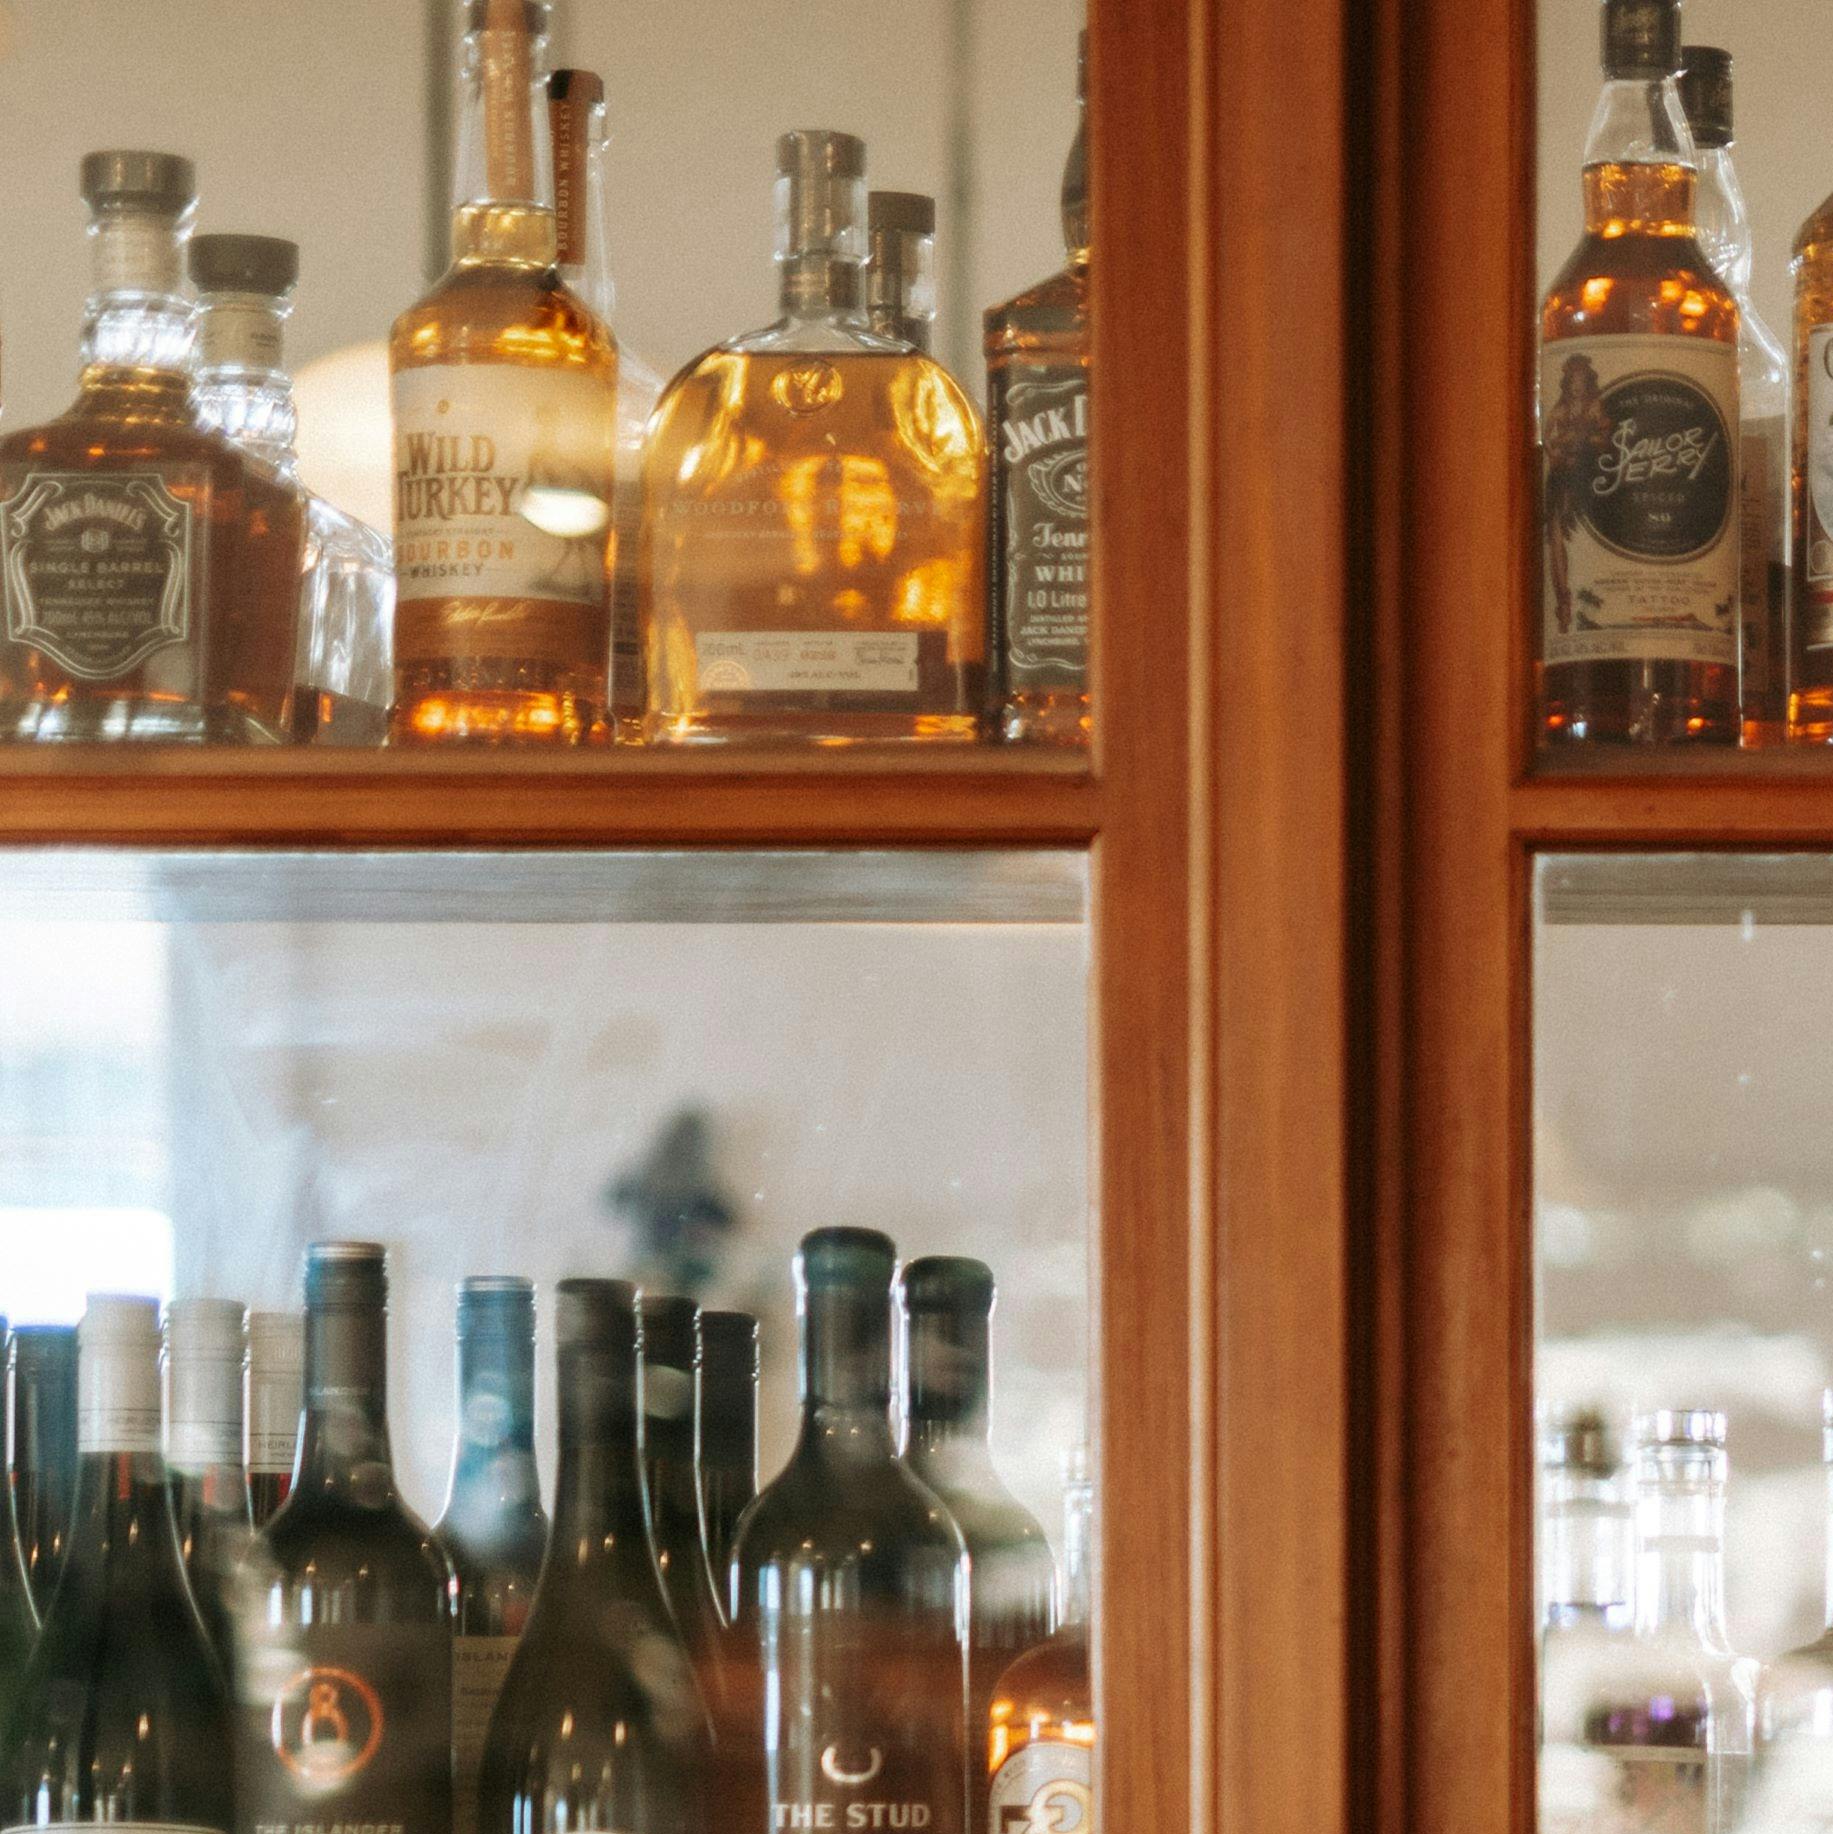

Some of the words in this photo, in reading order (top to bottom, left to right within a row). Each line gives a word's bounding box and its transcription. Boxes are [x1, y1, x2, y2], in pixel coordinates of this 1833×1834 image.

[403, 431, 497, 476] WILD
[1003, 406, 1071, 463] JACK
[397, 470, 520, 522] TURKEY
[410, 563, 483, 579] WHISKEY
[774, 1803, 835, 1829] THE
[845, 1803, 932, 1829] STUD
